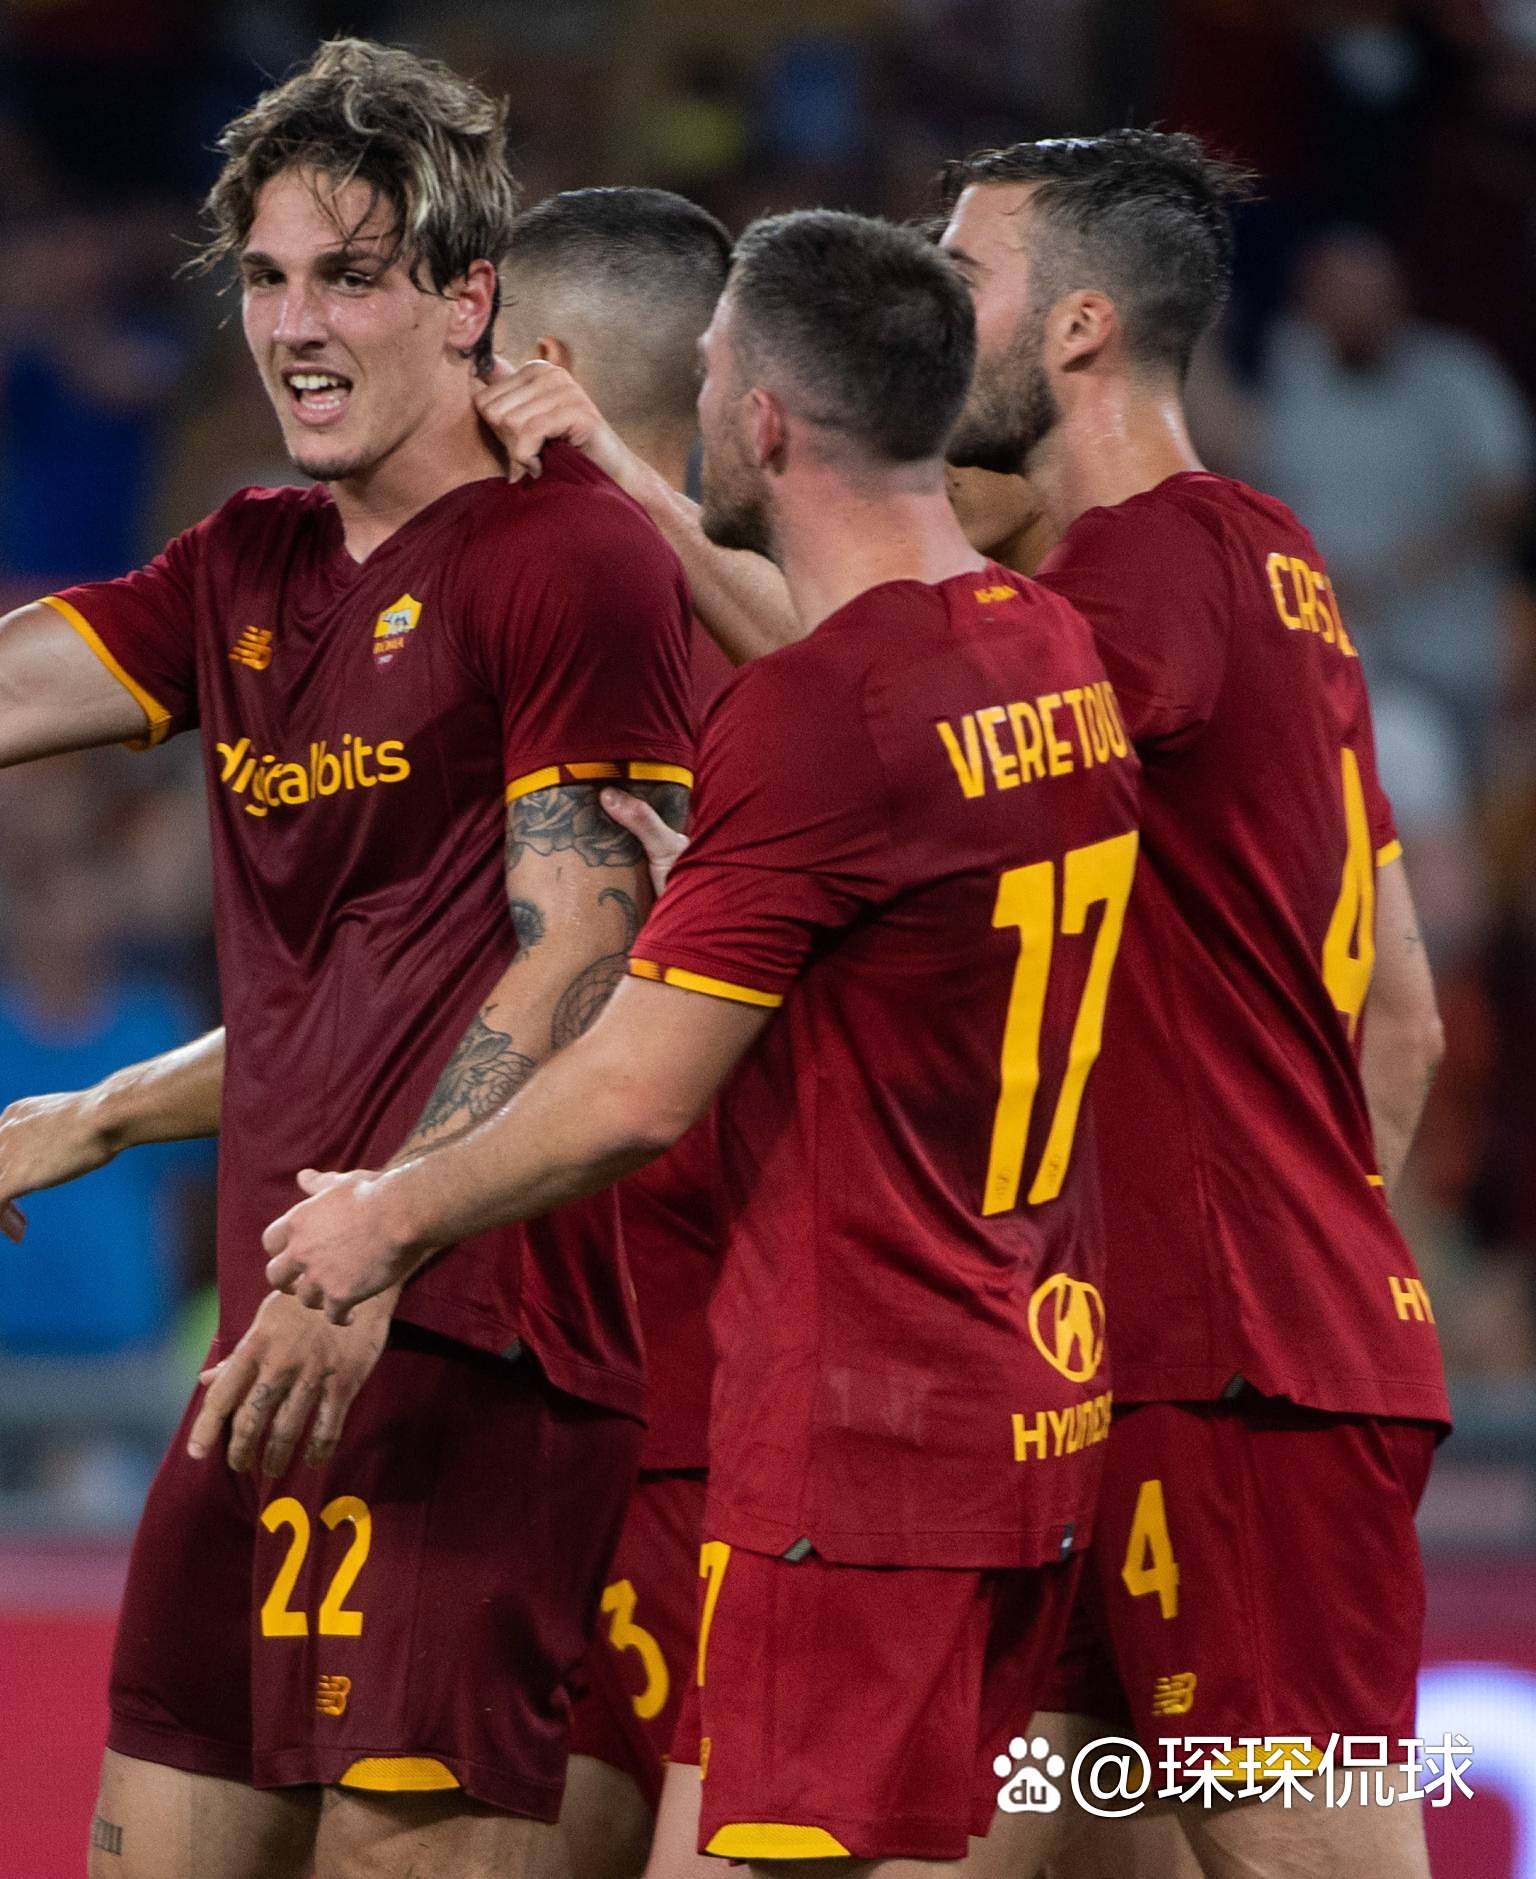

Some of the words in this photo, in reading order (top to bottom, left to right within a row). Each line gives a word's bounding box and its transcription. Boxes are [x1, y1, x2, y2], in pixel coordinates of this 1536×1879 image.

[936, 680, 1128, 799] VERETOU
[1321, 746, 1375, 1041] 4
[981, 829, 1139, 1217] 17
[260, 1495, 372, 1637] 22
[1121, 1479, 1181, 1620] 4
[600, 1578, 670, 1720] 3
